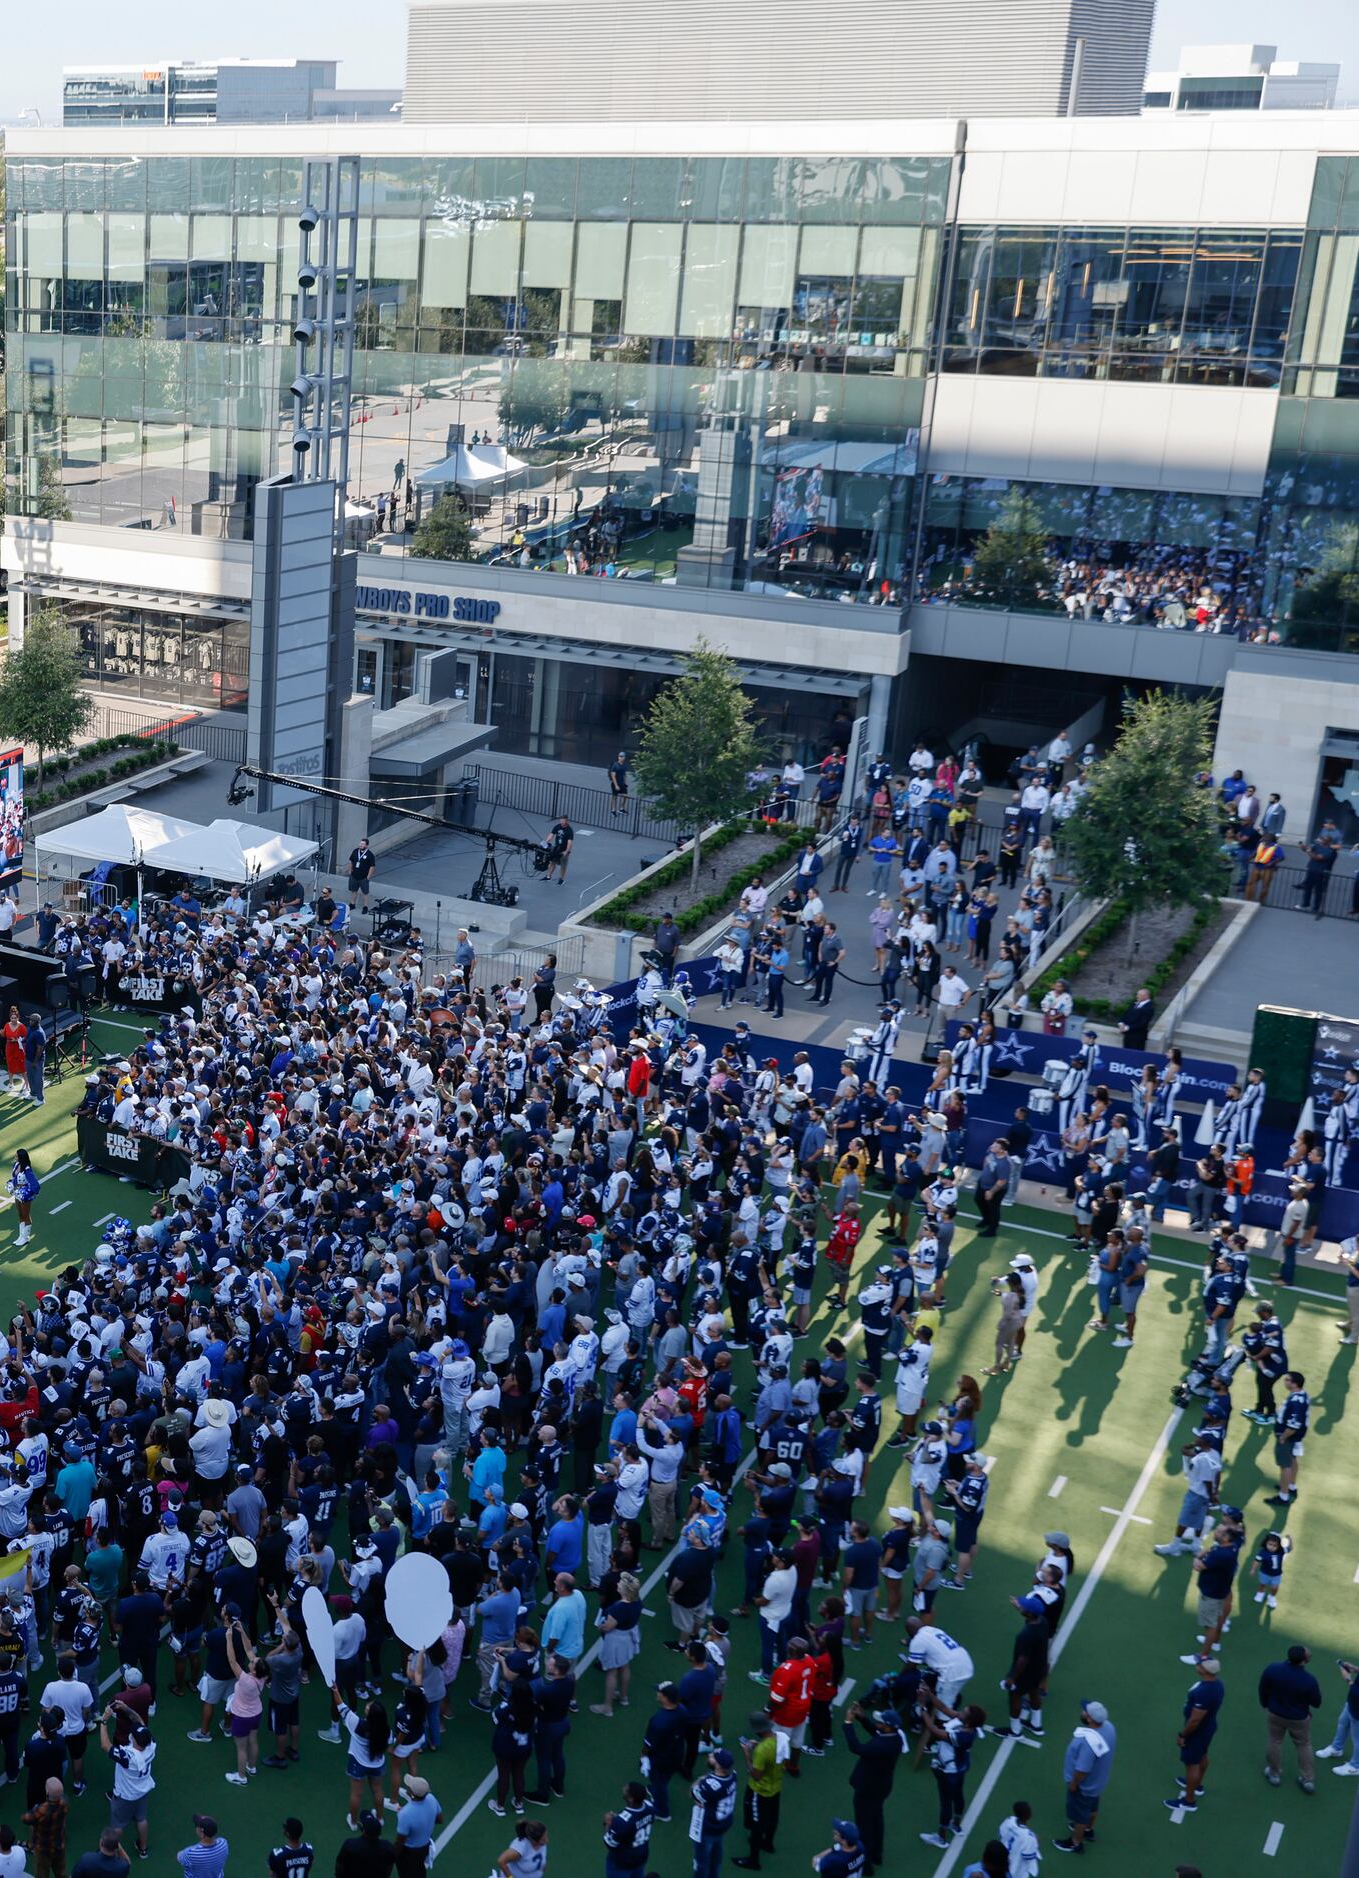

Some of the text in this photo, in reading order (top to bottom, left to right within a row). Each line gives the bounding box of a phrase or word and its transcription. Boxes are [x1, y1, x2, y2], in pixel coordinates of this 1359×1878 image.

[356, 586, 501, 624] WBOYS PRO SHOP
[129, 978, 165, 990] FIRST
[131, 989, 164, 1000] TAKE
[107, 1133, 141, 1149] FIRST
[108, 1146, 139, 1162] TAKE
[91, 1396, 110, 1406] PRESCOTT
[14, 1409, 35, 1421] NAUTICA
[96, 1404, 106, 1421] 4
[116, 1450, 135, 1462] PRESCOTT
[776, 1441, 804, 1460] 60
[27, 1450, 47, 1476] 99
[122, 1459, 132, 1476] 4
[319, 1490, 337, 1499] PARSONS
[142, 1494, 152, 1515] 8
[315, 1500, 331, 1522] 11
[165, 1552, 177, 1571] 4
[0, 1684, 17, 1694] LAMB
[285, 1856, 309, 1868] PARSONS
